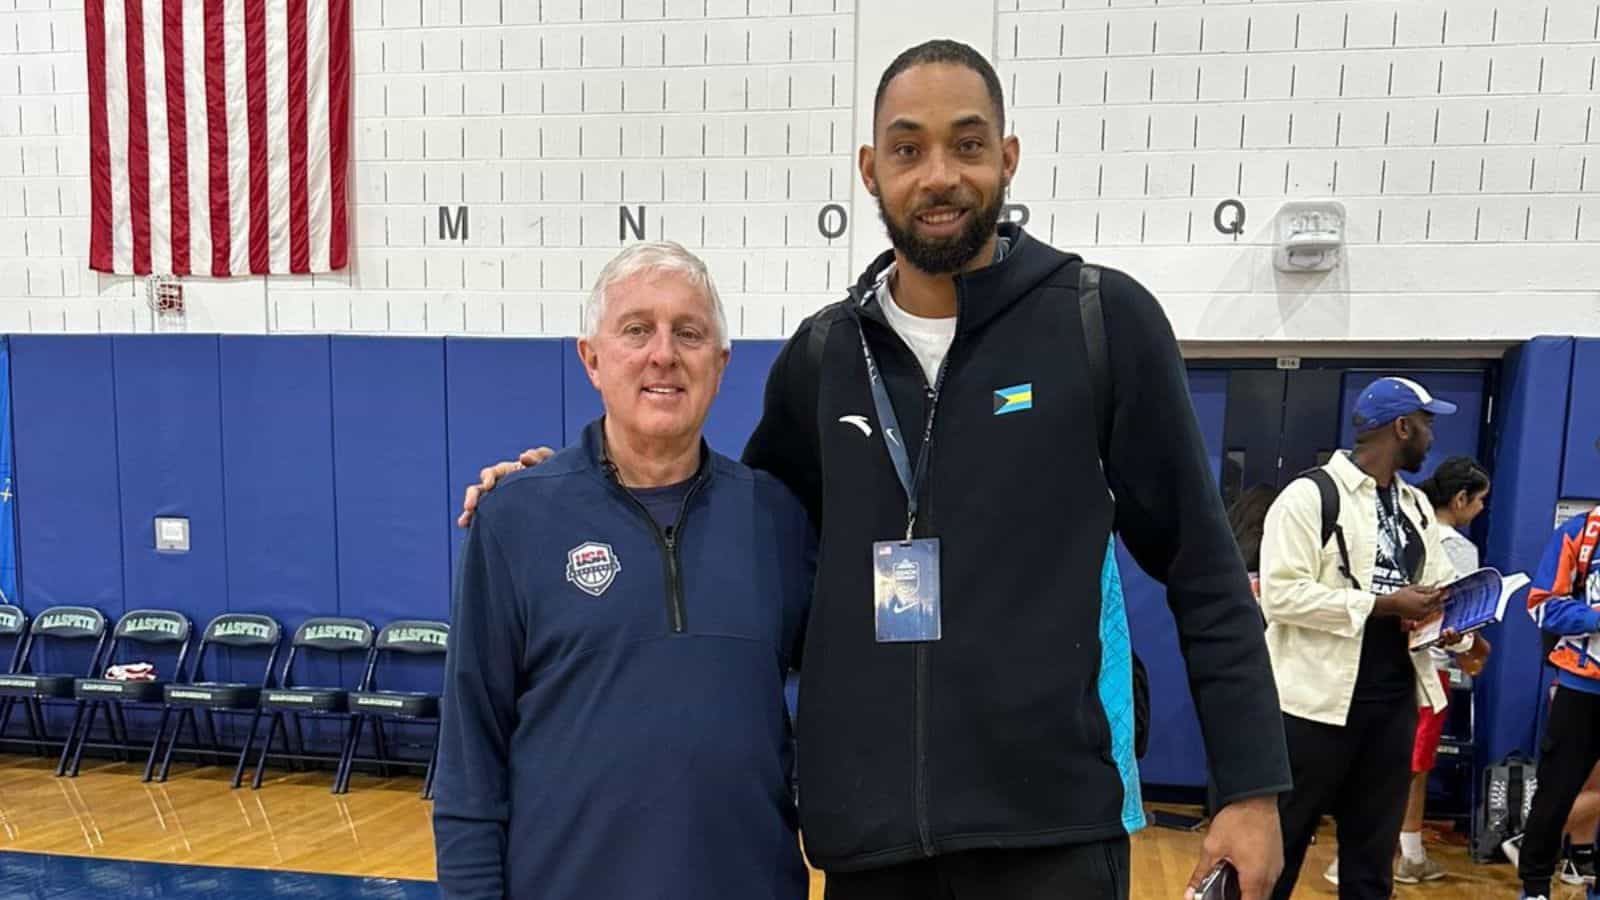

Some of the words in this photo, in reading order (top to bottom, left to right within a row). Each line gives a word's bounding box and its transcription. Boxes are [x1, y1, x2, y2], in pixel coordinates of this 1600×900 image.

[438, 205, 469, 240] M
[619, 205, 646, 240] N
[817, 203, 848, 239] O
[1213, 199, 1246, 235] Q
